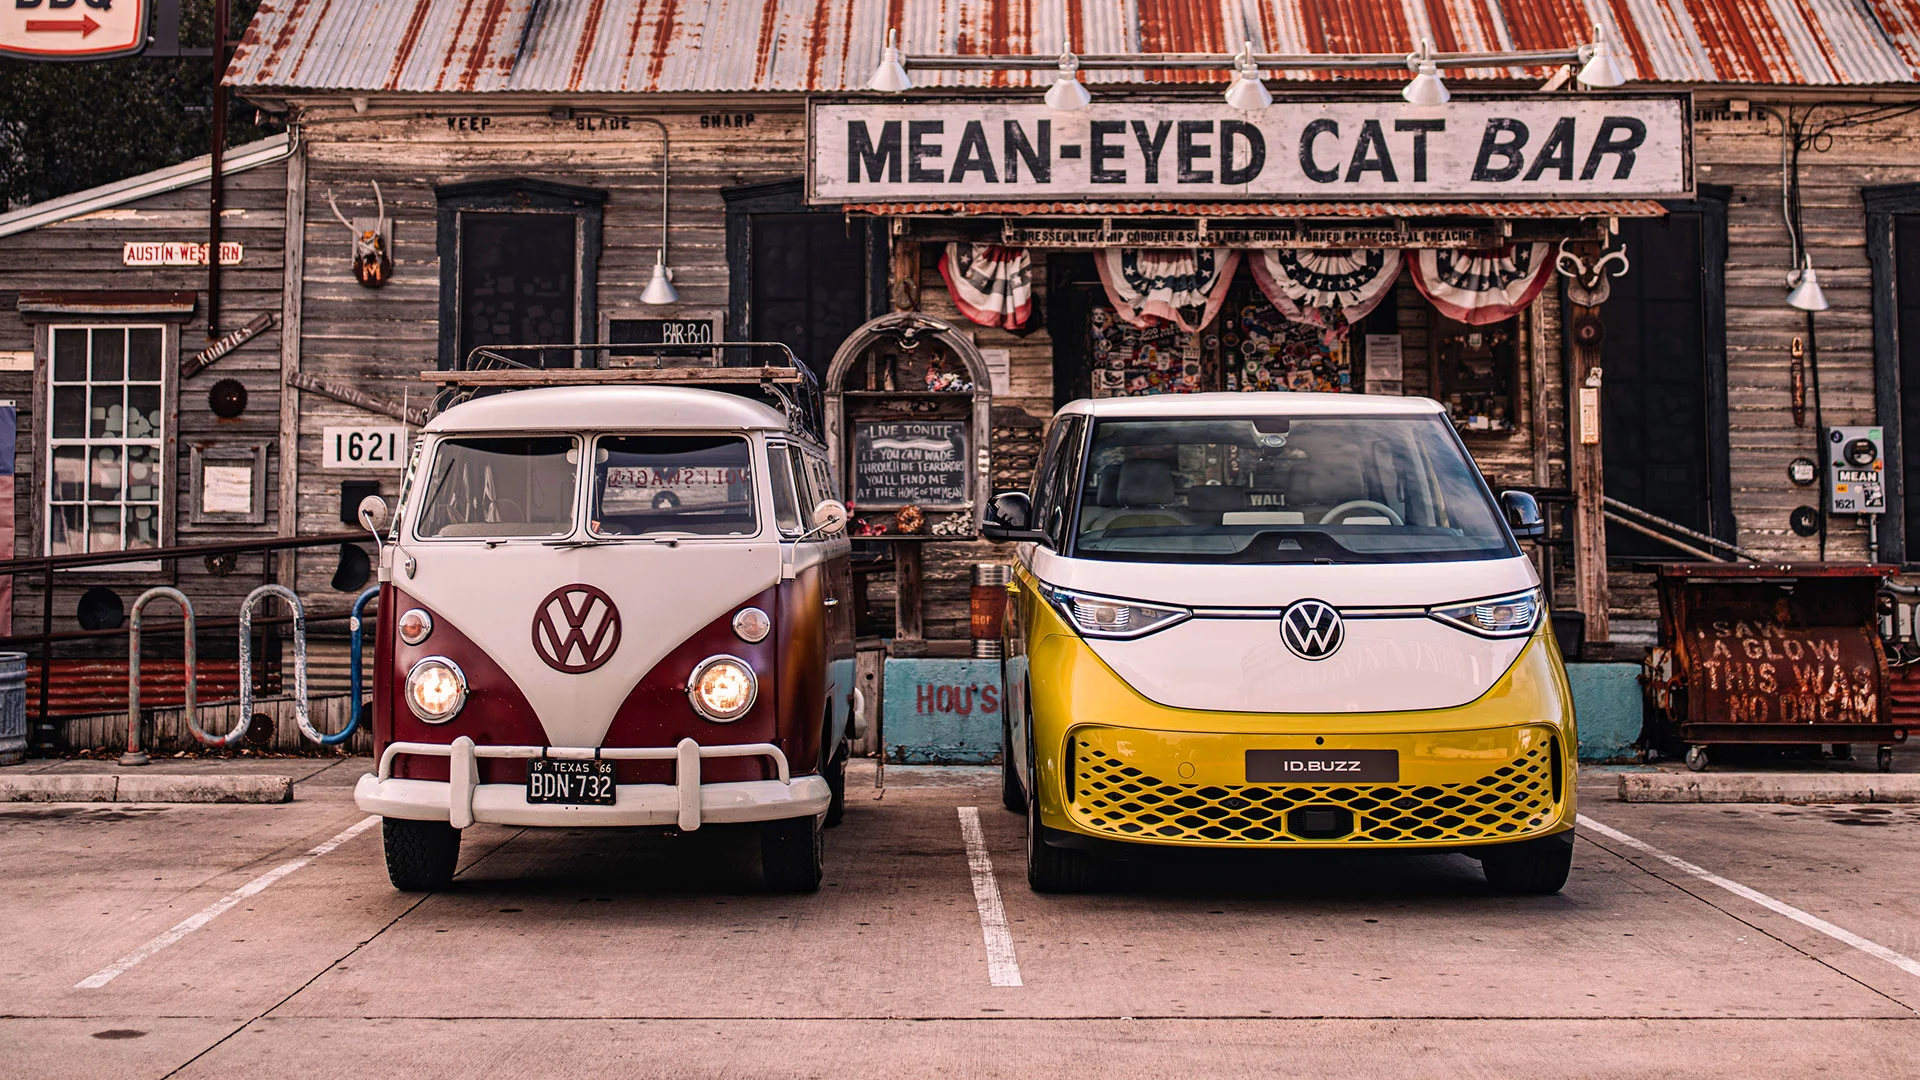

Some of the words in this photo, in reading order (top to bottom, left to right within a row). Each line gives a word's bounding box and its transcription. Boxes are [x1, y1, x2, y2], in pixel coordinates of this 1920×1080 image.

[447, 117, 491, 131] KEEP
[576, 116, 631, 131] BLADE
[700, 113, 755, 129] SHARP
[847, 119, 1266, 184] MEAN-EYED
[1300, 118, 1446, 183] CAT
[1470, 116, 1647, 182] BAR
[1071, 231, 1095, 242] LIKE
[1253, 231, 1296, 242] GUNMAN
[127, 246, 239, 261] AUSTIN-WESRN
[197, 326, 253, 366] KOOZIES
[870, 425, 898, 439] LIVE
[904, 425, 952, 440] TONITE
[336, 432, 395, 461] 1621
[880, 449, 899, 460] YOU
[901, 449, 922, 460] CAN
[925, 450, 956, 460] WADE
[859, 461, 899, 474] THROUGH
[900, 474, 926, 485] FIND
[928, 474, 948, 485] ME
[1839, 471, 1878, 482] MEAN
[857, 488, 870, 498] AT
[875, 488, 896, 498] THE
[898, 487, 920, 499] HOME
[1835, 499, 1856, 509] 1621
[1712, 620, 1786, 639] SAW
[1712, 639, 1732, 659] A
[1742, 638, 1839, 662] GLOW
[1703, 660, 1777, 693] THIS
[1792, 663, 1872, 695] WAS
[1726, 693, 1768, 723] NO
[534, 762, 543, 771] 19
[553, 762, 589, 773] TEXAS
[600, 763, 612, 773] 66
[1284, 761, 1361, 771] ID.BUZZ
